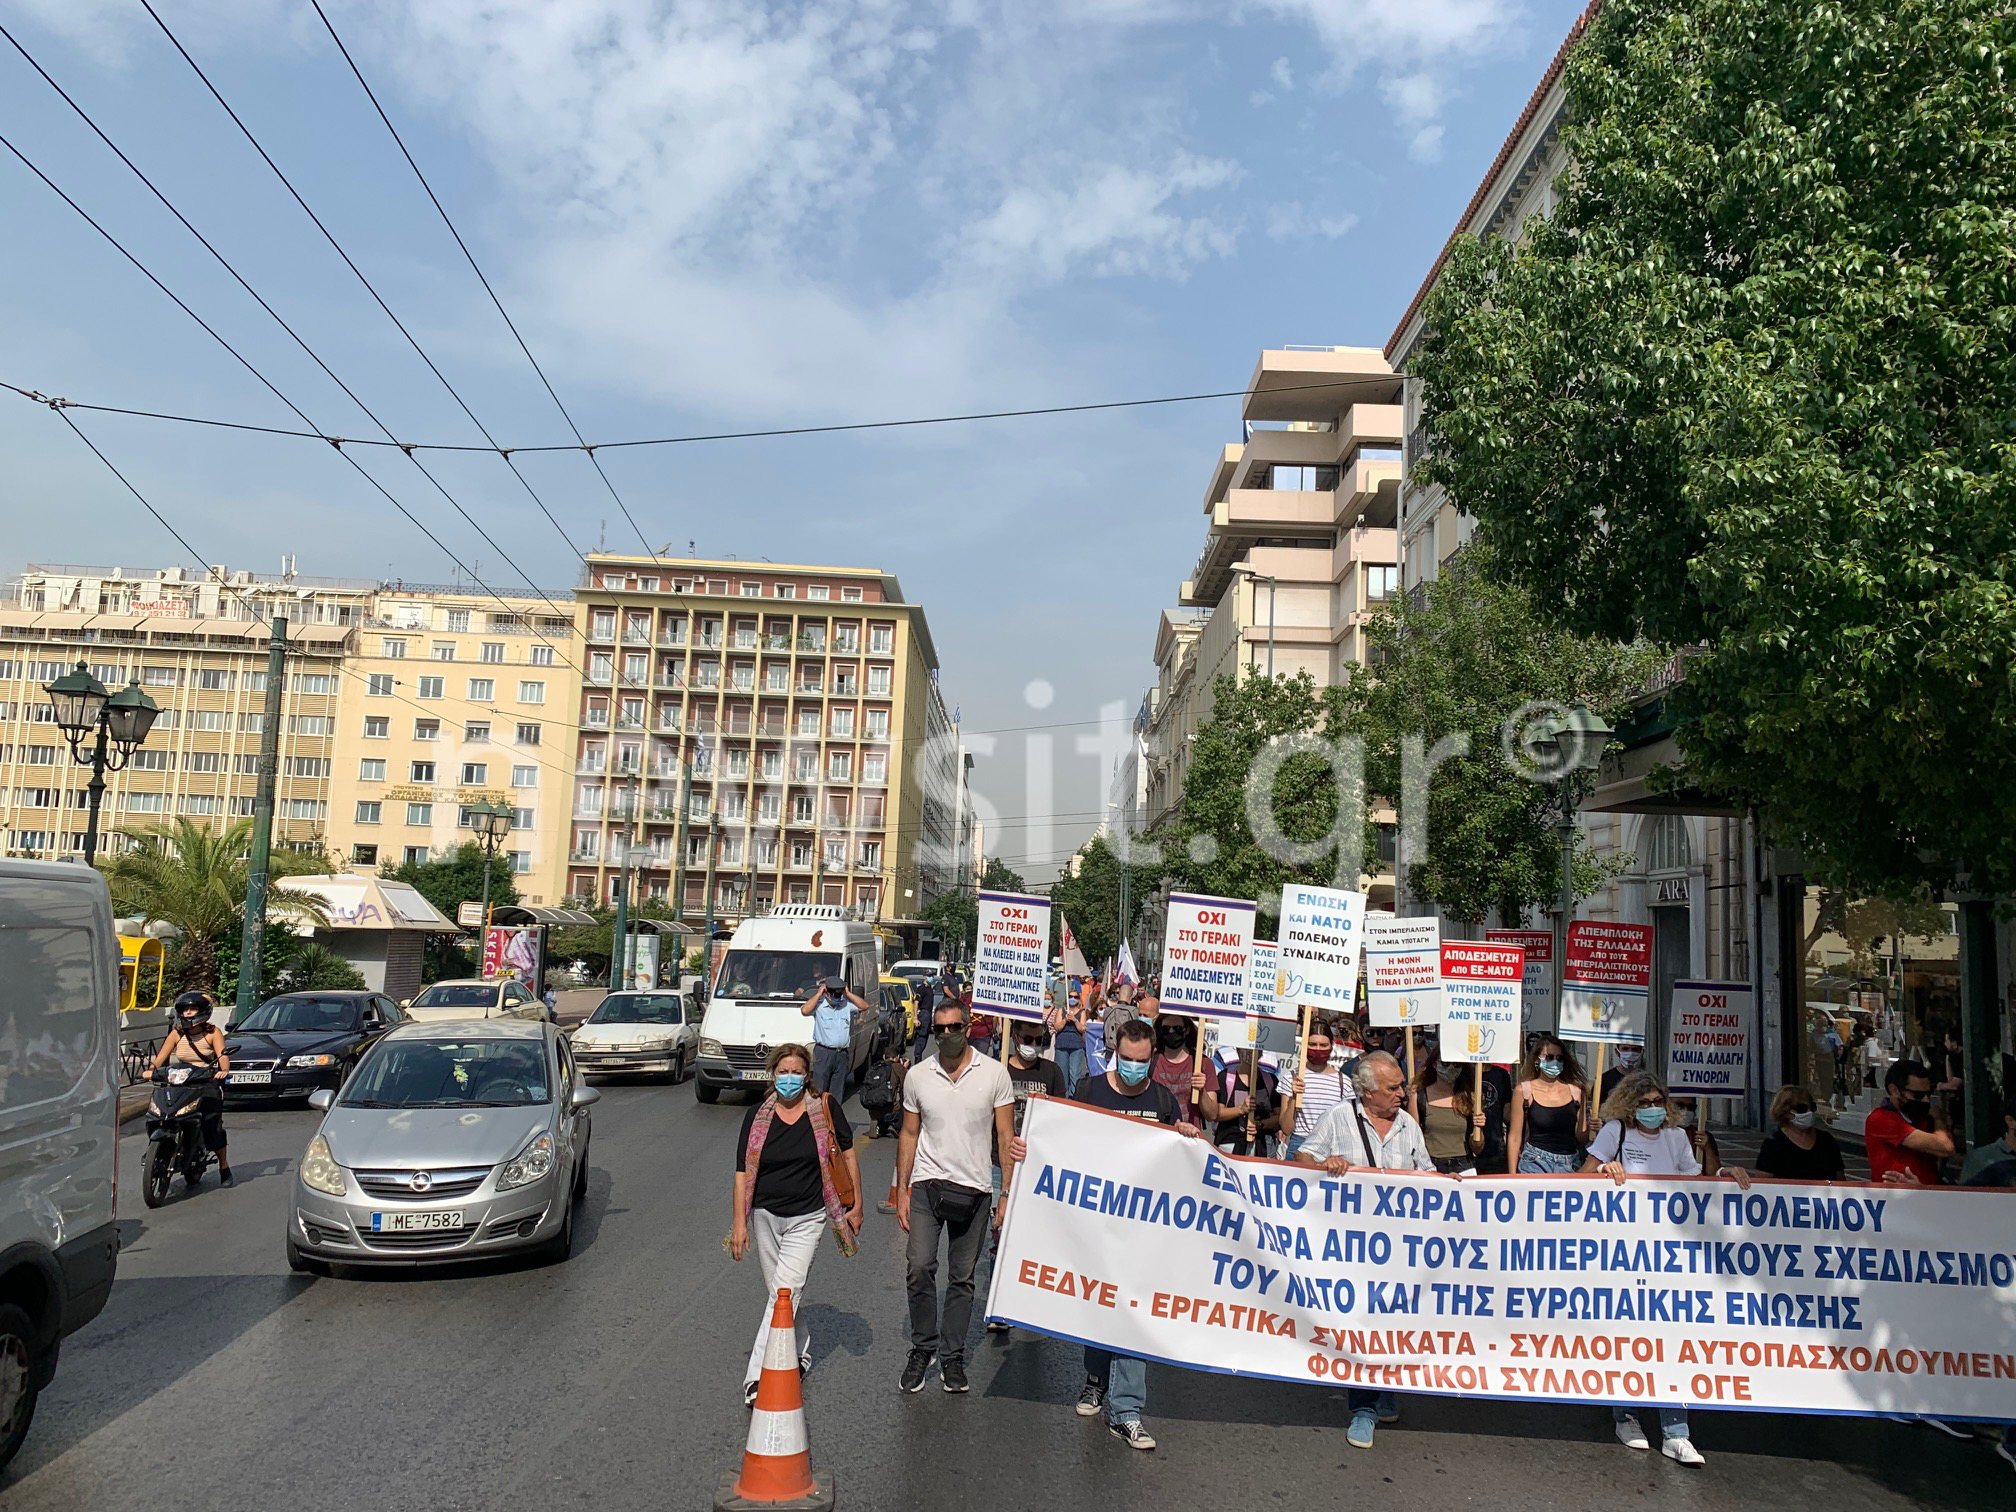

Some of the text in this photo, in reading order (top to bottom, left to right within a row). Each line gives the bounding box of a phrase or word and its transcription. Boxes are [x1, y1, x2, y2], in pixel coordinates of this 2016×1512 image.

[391, 790, 444, 798] ΟΡΓΑΝΙΣΜΟΣ
[1656, 879, 1689, 900] ZARA
[682, 904, 722, 912] ΥΠΟΥΡΙΟ
[1297, 893, 1348, 911] ΕΝΩΣΗ
[1001, 907, 1028, 919] ΟΧΙ
[1197, 910, 1226, 926] ΟΧΙ
[990, 921, 1038, 935] ΣΤΟ ΓΕΡΑΚΙ
[1289, 913, 1352, 931] ΚΑΙ ΝΑΤΟ
[1389, 926, 1436, 934] ΙΜΠΕΡΙΑΛΙΣΜΟ
[1578, 926, 1644, 940] ΑΠΕΜΠΛΟΚΗ
[983, 934, 1043, 950] ΤΟΥ ΠΟΛΕΜΟΥ
[1178, 929, 1241, 947] ΣΤΟ ΓΕΡΑΚΙ
[1289, 930, 1348, 947] ΠΟΛΕΜΟΥ
[1574, 938, 1646, 952] ΤΗΣ ΕΛΛΑΔΑΣ
[984, 947, 1040, 964] ΝΑ ΚΛΕΙΣΕΙ Η ΒΑΣΗ
[1169, 948, 1247, 967] ΤΟΥ ΠΟΛΕΜΟΥ
[1282, 948, 1350, 966] ΣΥΝΔΙΚΑΤΟ
[1397, 956, 1421, 964] ΜΟΝΗ
[1444, 950, 1520, 963] ΑΠΟΔΕΣΜΕΥΣΗ
[1590, 951, 1628, 961] ΑΠΟ ΤΟΥΣ
[979, 961, 1043, 978] ΤΗΣ ΣΟΥΔΑΣ ΚΑΙ ΟΛΕΣ
[1375, 966, 1434, 976] ΥΠΕΡΔΥΝΑΜΗ
[1450, 965, 1514, 976] ΑΠΟ ΕΕ-ΝΑΤΟ
[1525, 966, 1541, 974] ΛΑΟ
[1566, 959, 1650, 973] ΙΜΠΕΡΙΑΛΙΣΤΙΚΟΥΣ
[1170, 966, 1242, 986] ΑΠΟΔΕΣΜΕΥΣΗ
[1414, 976, 1434, 984] ΛΑΟΙ
[1522, 977, 1537, 985] ΝΤΗ
[1576, 970, 1638, 982] ΣΧΕΔΙΑΣΜΟΥΣ
[979, 975, 1040, 992] ΟΙ ΕΥΡΩΑΤΛΑΝΤΙΚΕΣ
[1446, 984, 1516, 995] WITHDRAWAL
[976, 988, 996, 1000] ΒΑΣΕΙΣ
[1003, 992, 1041, 1007] ΣΤΡΑΤΗΓΕΙΑ
[1164, 986, 1244, 1006] ΑΠΟ ΝΑΤΟ ΚΑΙ ΕΕ
[1304, 983, 1351, 1000] ΕΕΔΥΕ
[1451, 998, 1510, 1008] FROM NATO
[1698, 994, 1727, 1008] ΟΧΙ
[1448, 1011, 1512, 1022] AND THE E.U
[1682, 1014, 1738, 1027] ΣΤΟ ΓΕΡΑΚΙ
[1674, 1032, 1745, 1046] ΤΟΥ ΠΟΛΕΜΟΥ
[1672, 1050, 1744, 1065] ΚΑΜΙΑ ΑΛΛΑΓΗ
[1682, 1069, 1730, 1084] ΣΥΝΟΡΩΝ
[1201, 1154, 1886, 1233] ΕΞΩ ΑΠΟ ΤΗ ΧΩΡΑ ΤΟ ΓΕΡΑΚΙ ΤΟΥ ΠΟΛΕΜΟΥ
[1033, 1164, 1246, 1242] ΑΠΕΜΠΛΟΚΗ
[1253, 1216, 1313, 1261] ΤΩΡΑ
[1322, 1228, 1391, 1265] ΑΠΟ
[1403, 1234, 1488, 1270] ΤΟΥΣ
[1500, 1238, 1804, 1278] ΙΜΠΕΡΙΑΛΙΣΤΙΚΟΥΣ
[1212, 1251, 1863, 1330] ΤΟΥ ΝΑΤΟ ΚΑΙ ΤΗΣ ΕΥΡΩΠΑΪΚΗΣ ΕΝΩΣΗΣ
[1018, 1259, 1118, 1308] ΕΕΔΥΕ
[1151, 1292, 1297, 1339] ΕΡΓΑΤΙΚΑ
[1309, 1326, 1476, 1356] ΣΥΝΔΙΚΑΤΑ
[1510, 1333, 1664, 1363] ΣΥΛΛΟΓΟΙ
[1678, 1339, 2016, 1380] ΑΥΤΟΠΑΣΧΟΛΟΥΜΕΝ
[1308, 1352, 1489, 1390] ΦΟΙΤΗΤΙΚΟΙ
[1500, 1366, 1656, 1398] ΣΥΛΛΟΓΟΙ
[1691, 1373, 1752, 1401] ΟΓΕ
